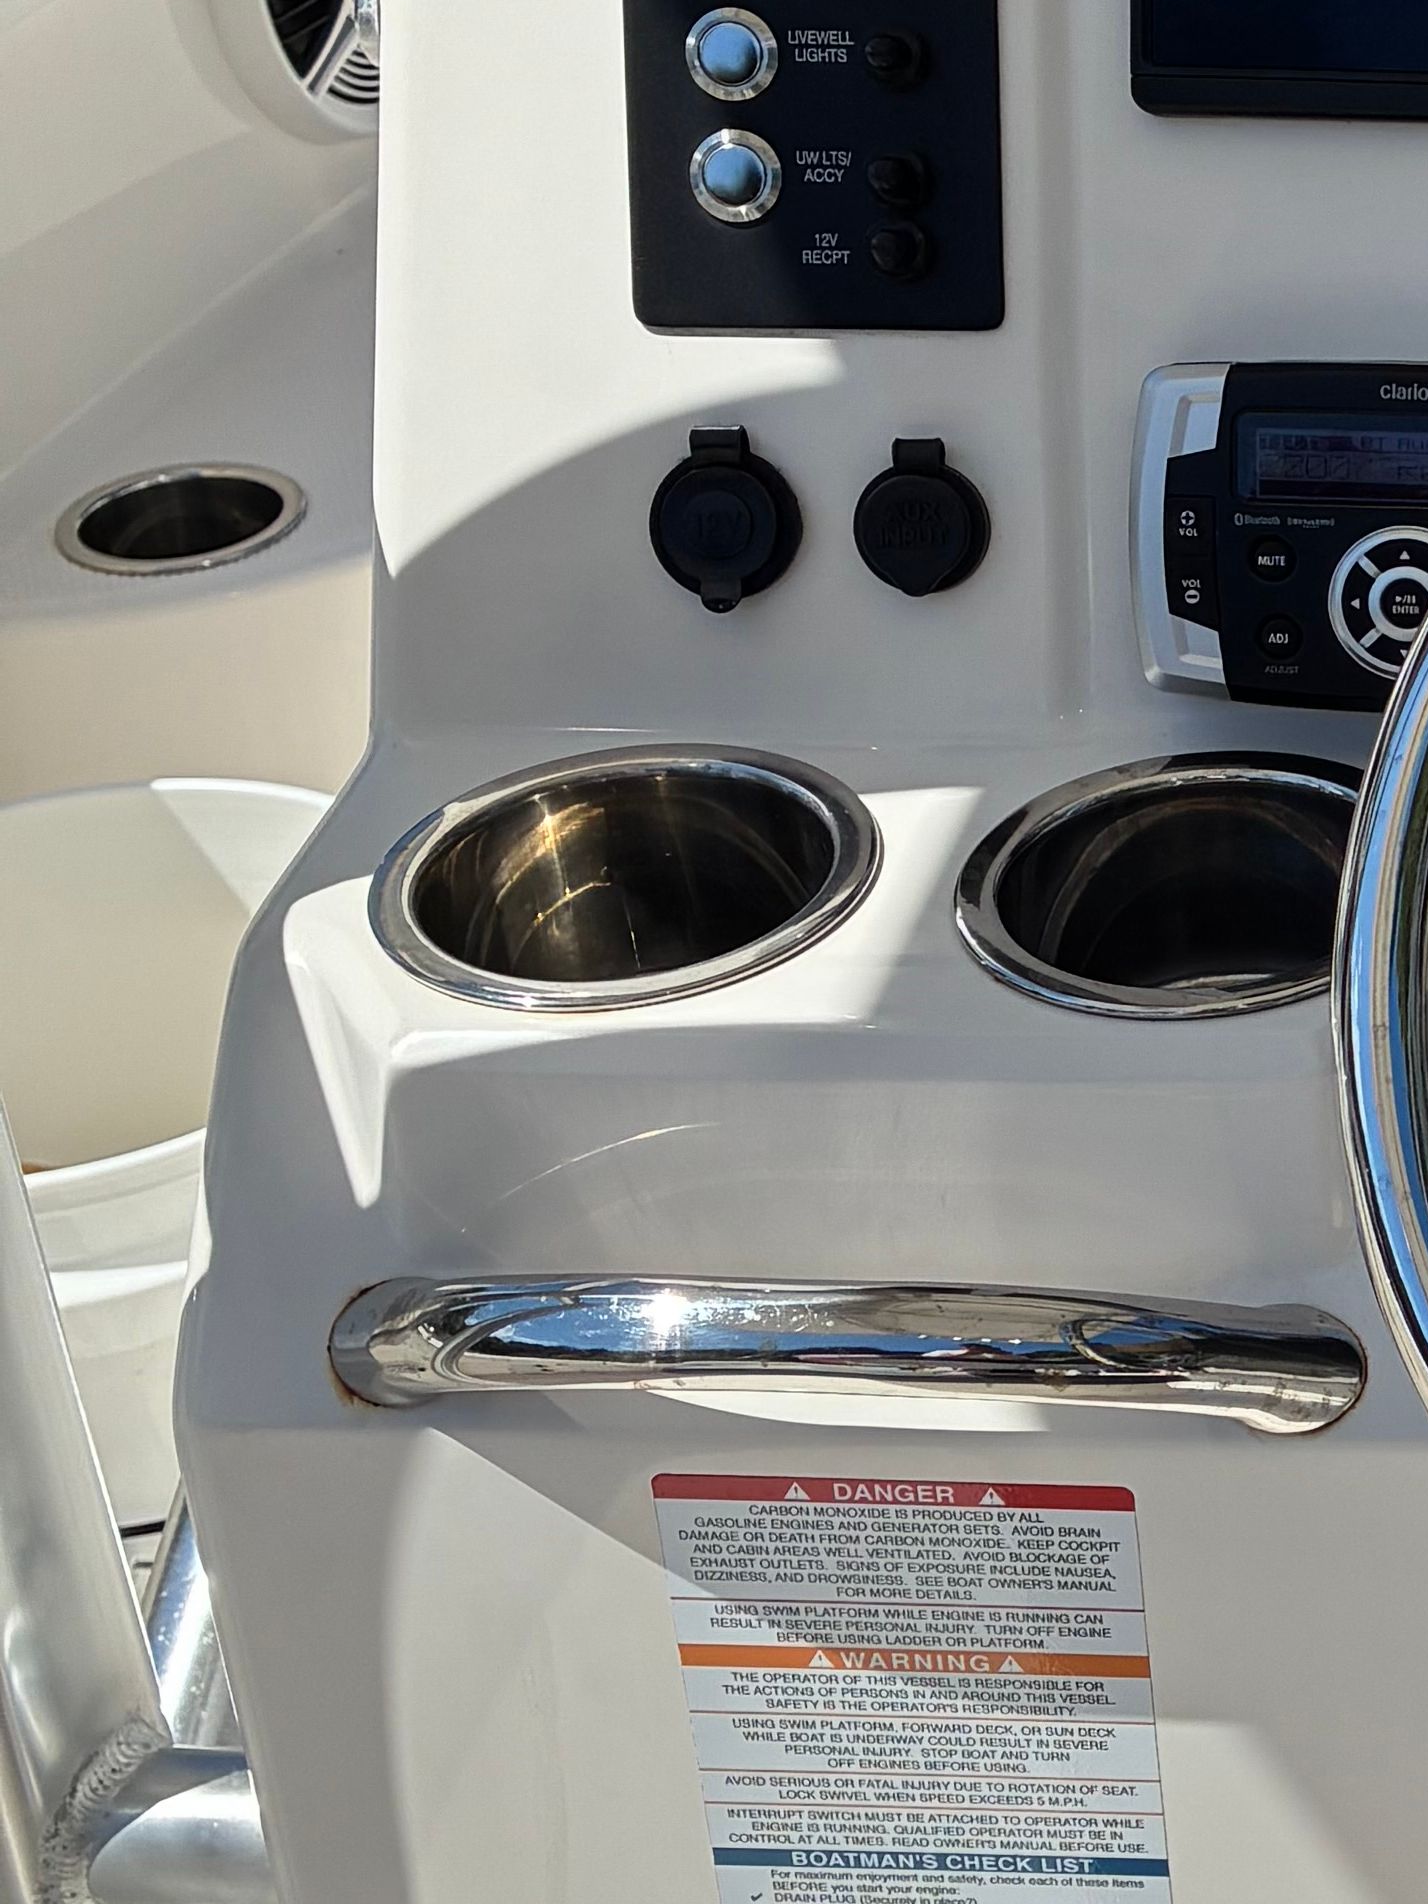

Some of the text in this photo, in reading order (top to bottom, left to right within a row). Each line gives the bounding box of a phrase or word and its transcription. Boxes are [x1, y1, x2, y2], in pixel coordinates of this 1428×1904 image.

[787, 29, 855, 48] LIVEWELL
[794, 47, 848, 65] LIGHTS
[795, 151, 852, 169] UW LTS/
[803, 167, 846, 184] ACCY
[814, 233, 839, 248] 12V
[802, 249, 851, 266] RECPT
[884, 503, 942, 522] AUX
[1179, 528, 1198, 537] VOL
[1257, 555, 1286, 566] MUTE
[1181, 579, 1201, 588] VOL
[1392, 605, 1421, 616] ENTER
[1268, 633, 1289, 644] ADJ
[833, 1483, 954, 1503] DANGER
[749, 1504, 1045, 1524] CARBON MONOXIDE IS PRODUCED BY ALL
[840, 1653, 990, 1673] WARNING
[791, 1851, 1094, 1873] BOATMAN'S CHECK LIST
